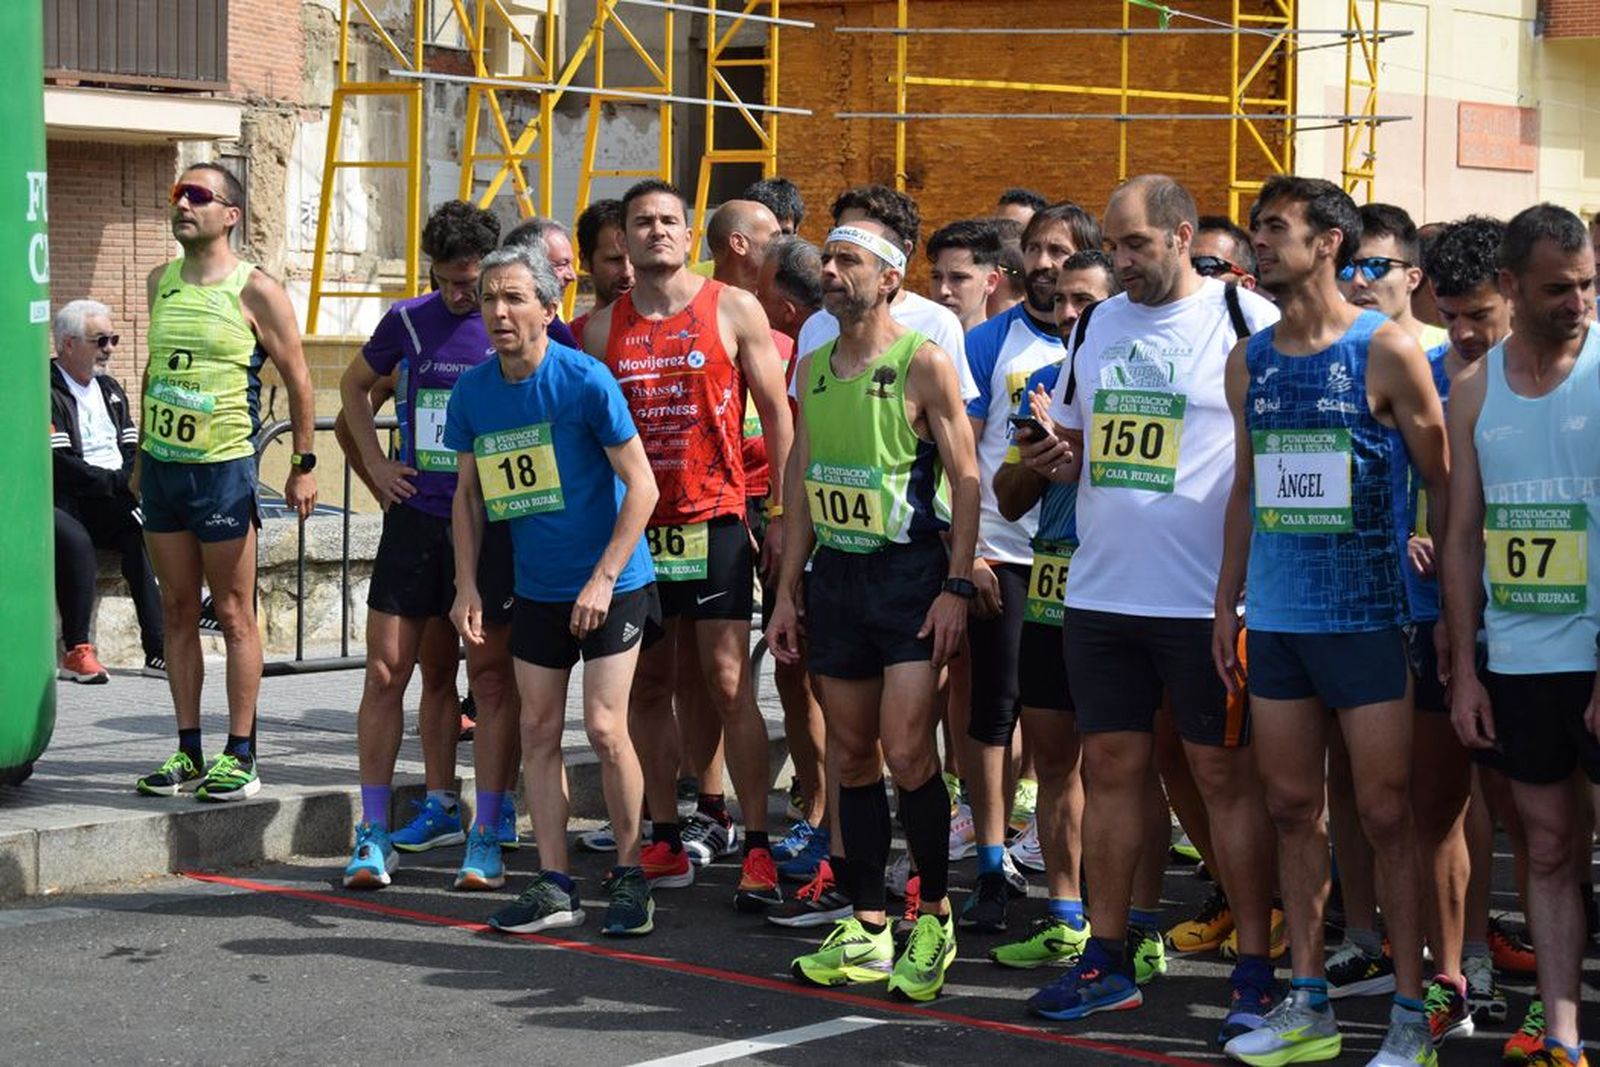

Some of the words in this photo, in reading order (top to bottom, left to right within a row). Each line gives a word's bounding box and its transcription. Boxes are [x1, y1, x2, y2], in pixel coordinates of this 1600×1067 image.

[618, 355, 686, 373] Movijerez
[150, 403, 196, 442] 136
[1101, 419, 1165, 460] 150
[498, 454, 537, 491] 18
[1105, 468, 1128, 480] CAJA
[1130, 470, 1169, 484] RURAL
[1277, 469, 1325, 498] ÁNGEL
[532, 495, 560, 508] RURAL
[815, 487, 871, 527] 104
[1281, 513, 1305, 525] CAJA
[1309, 513, 1346, 526] RURAL
[645, 525, 685, 556] 86
[1507, 537, 1557, 578] 67
[1037, 563, 1069, 601] 65
[1511, 592, 1535, 604] CAJA
[1537, 592, 1580, 604] RURAL
